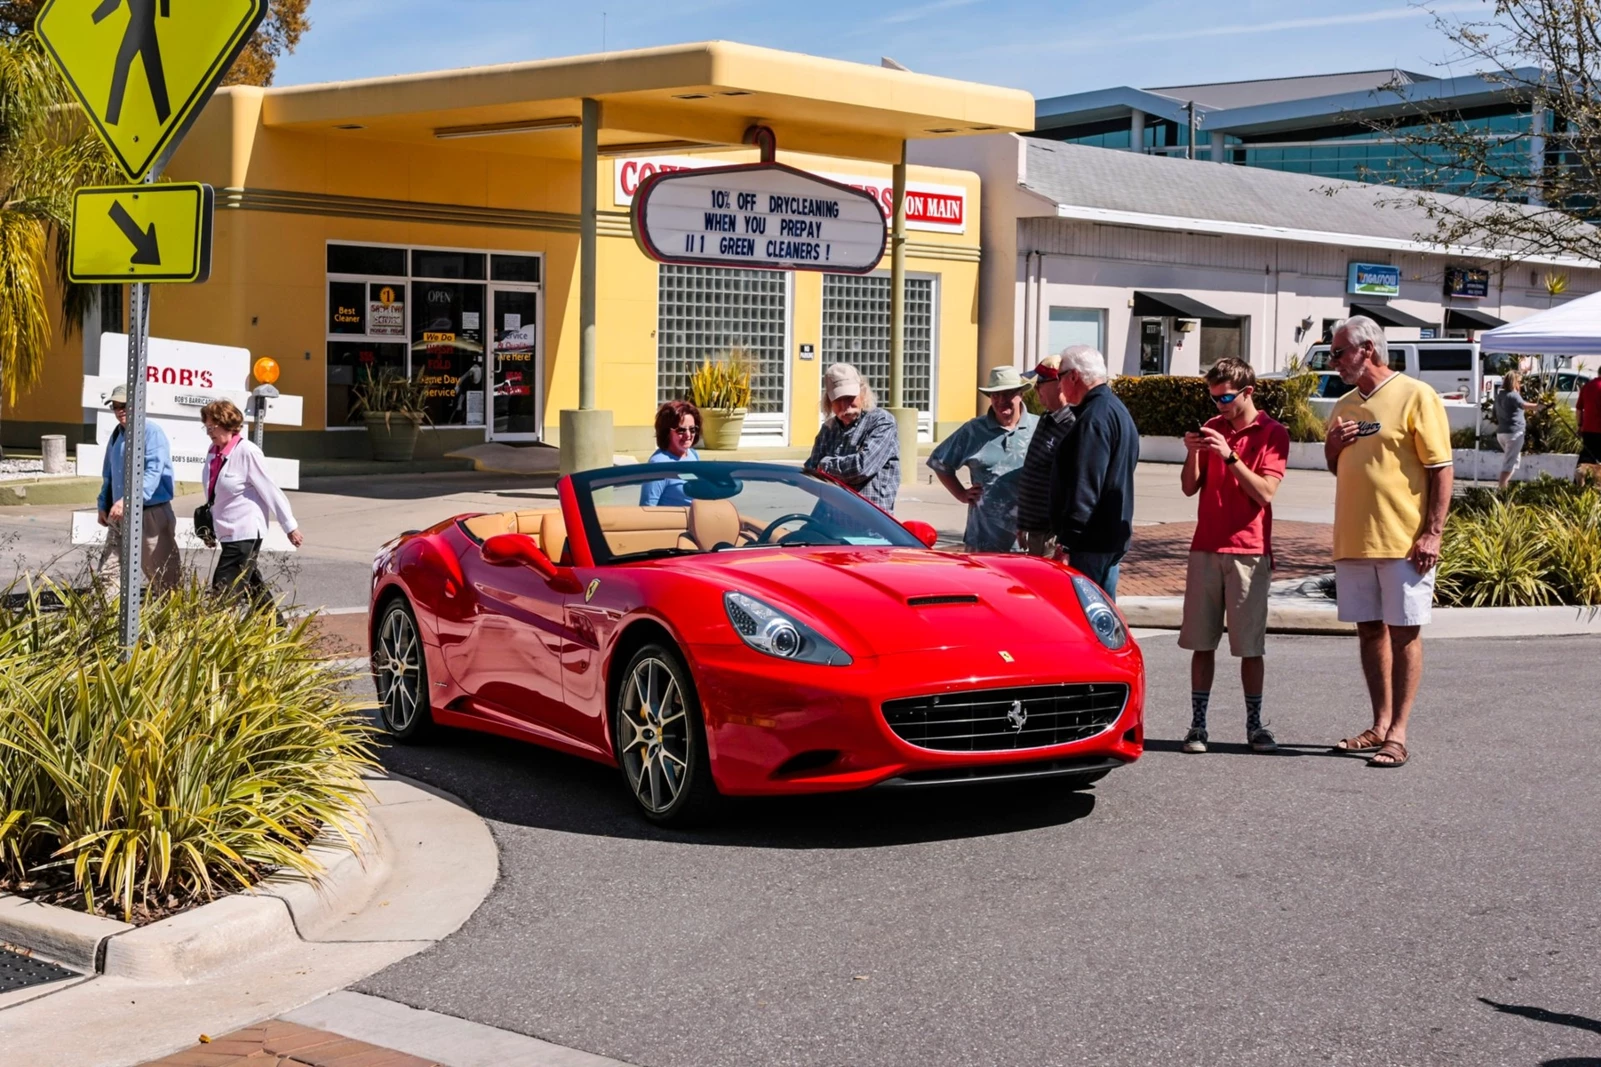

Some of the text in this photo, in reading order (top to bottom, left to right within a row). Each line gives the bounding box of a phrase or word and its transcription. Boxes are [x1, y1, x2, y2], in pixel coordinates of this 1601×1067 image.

[711, 189, 839, 218] 10% OFF DRYCLEANING
[905, 195, 961, 219] ON MAIN
[704, 212, 822, 239] WHEN YOU PREPAY
[719, 236, 755, 256] GREEN
[766, 240, 820, 261] CLEANERS
[427, 290, 451, 303] OPEN
[338, 306, 356, 315] Best
[334, 314, 360, 323] Cleaner
[426, 333, 452, 341] We Do
[146, 365, 213, 388] BOB'S
[174, 395, 188, 404] BOB'S
[172, 455, 186, 463] BOB'S
